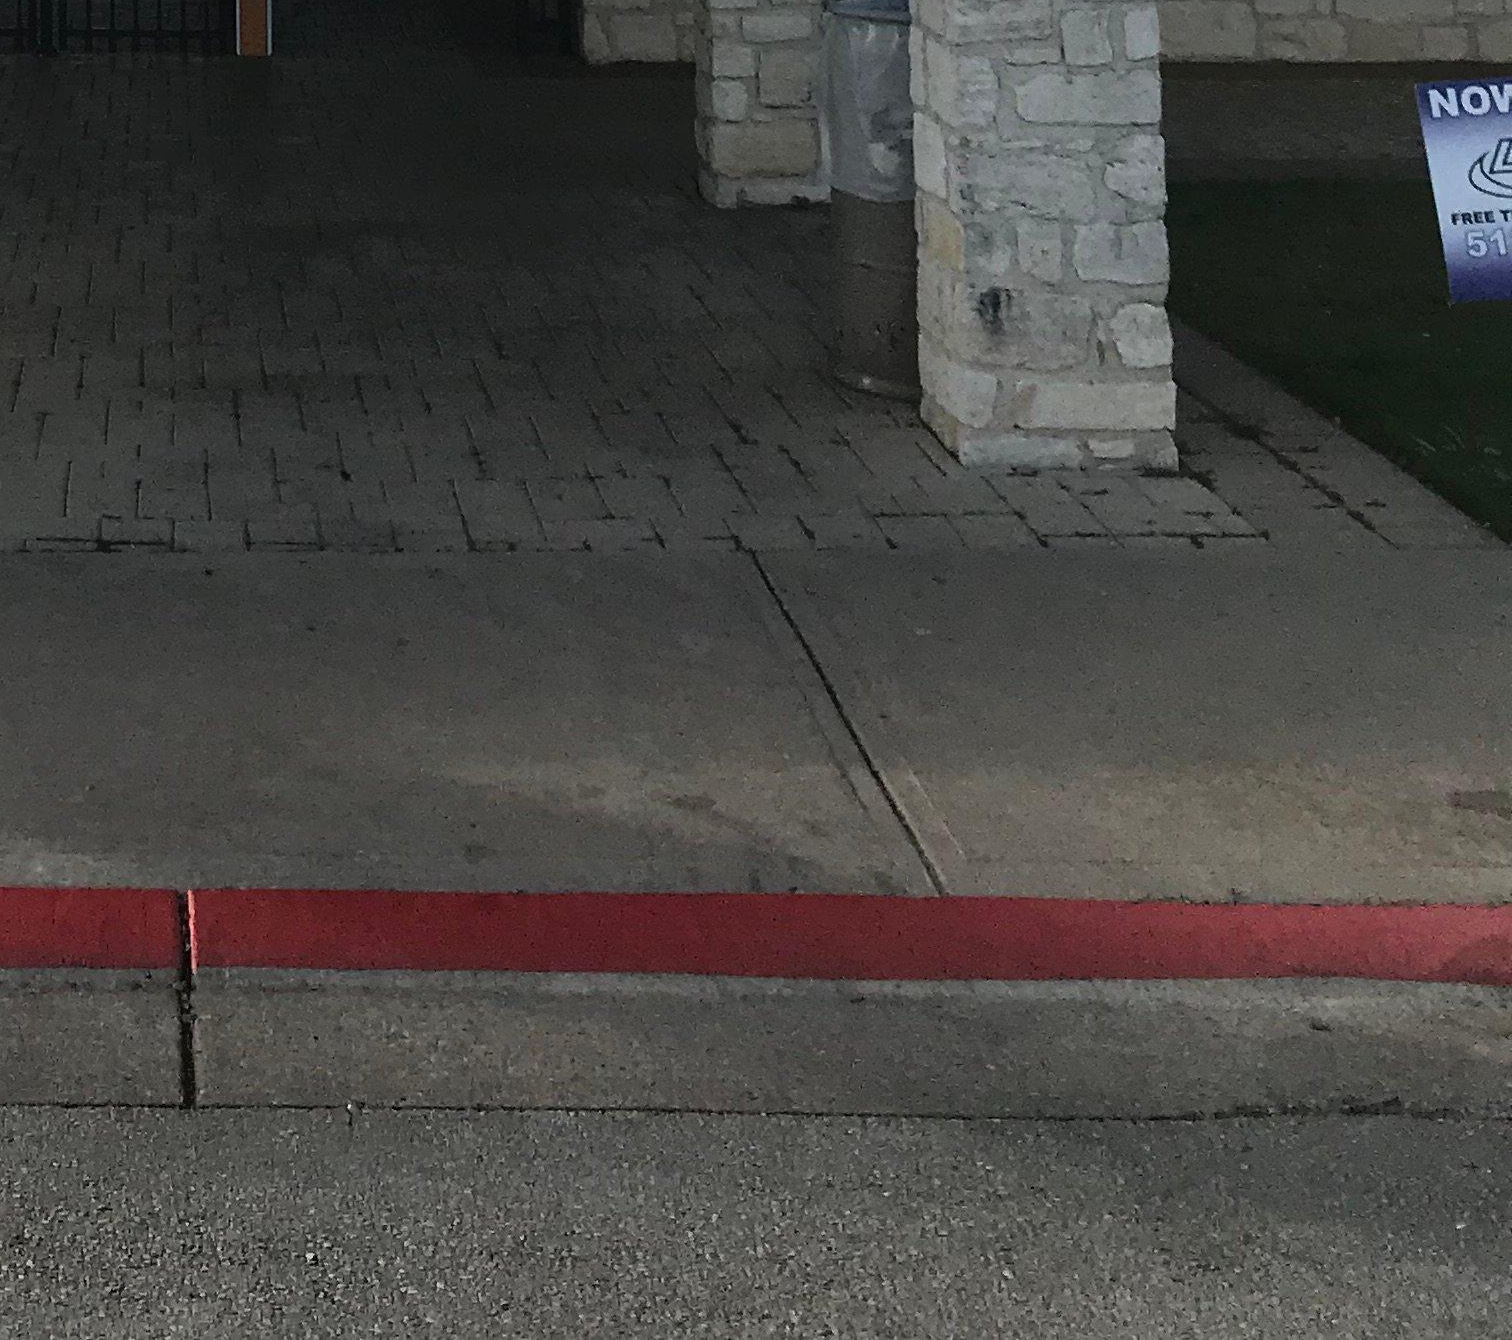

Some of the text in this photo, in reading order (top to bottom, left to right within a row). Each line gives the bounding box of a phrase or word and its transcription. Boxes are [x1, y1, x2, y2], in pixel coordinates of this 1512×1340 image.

[1427, 83, 1512, 118] NOW
[1450, 209, 1512, 226] FREE T
